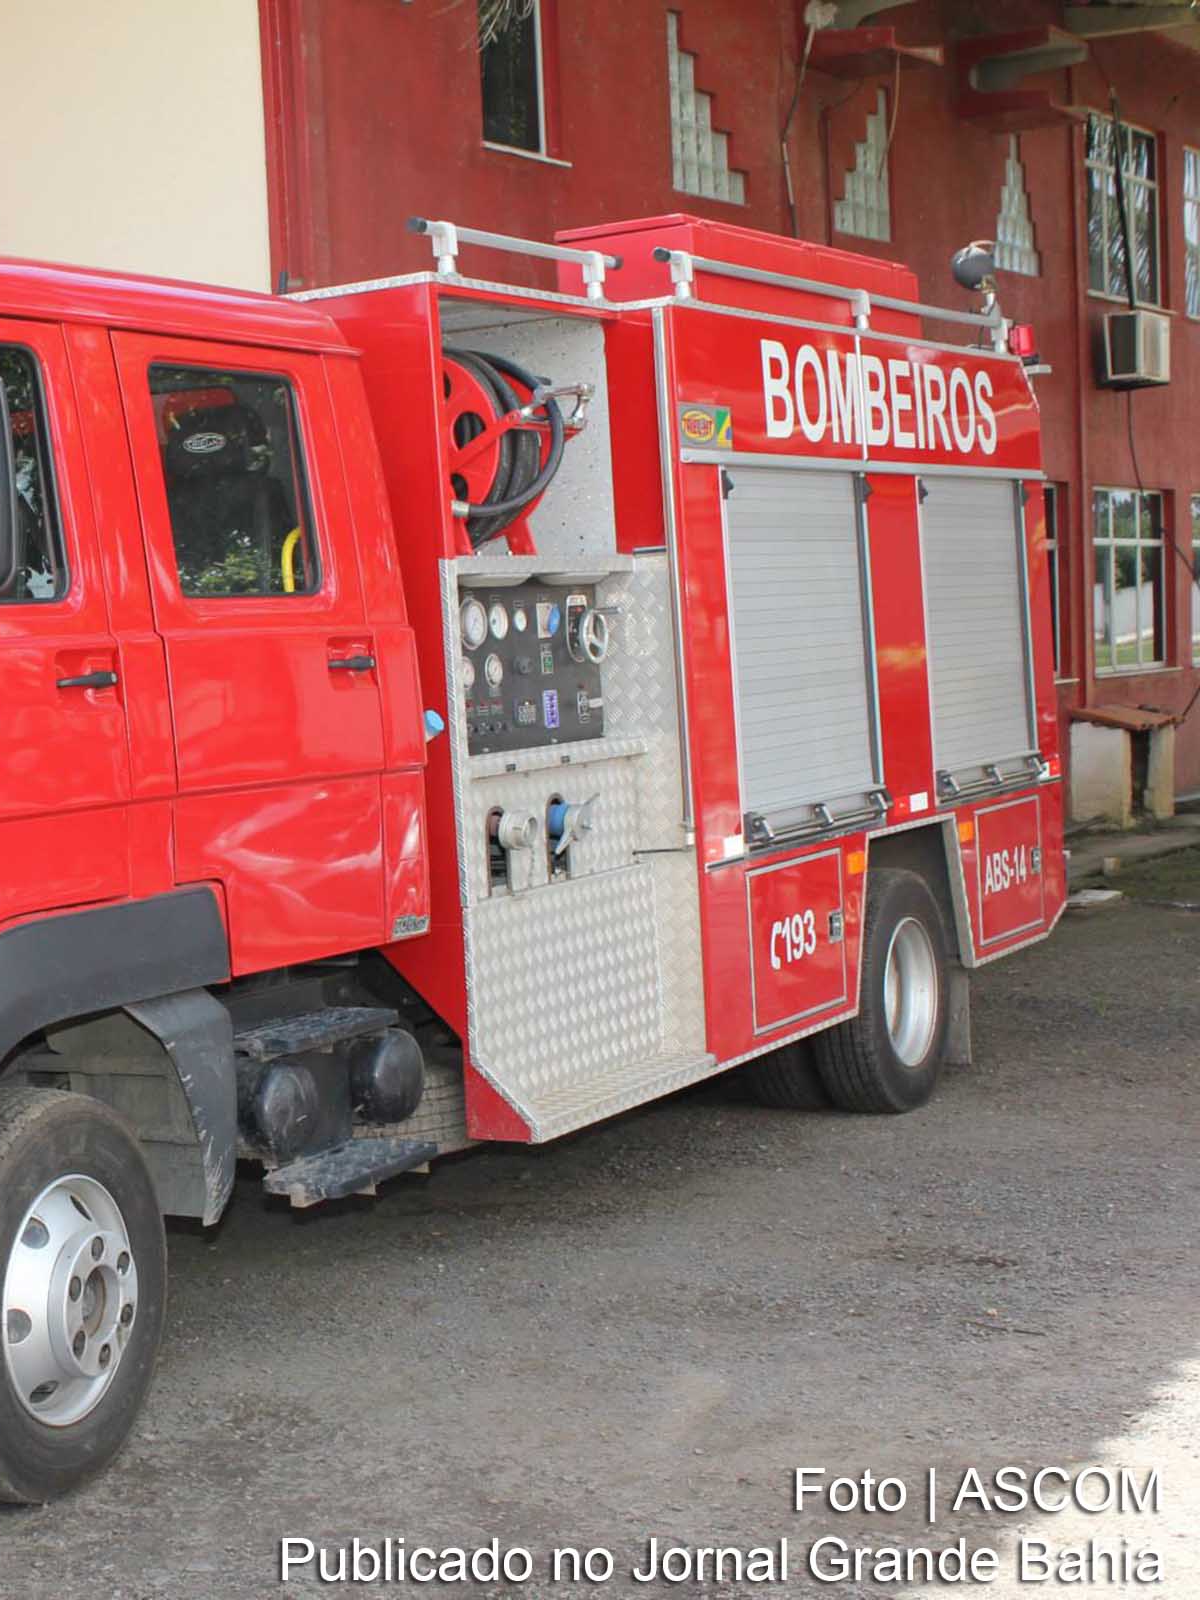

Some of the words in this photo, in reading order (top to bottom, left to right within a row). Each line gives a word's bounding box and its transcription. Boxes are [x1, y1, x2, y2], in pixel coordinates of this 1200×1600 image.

[760, 338, 998, 455] BOMBEIROS
[984, 844, 1027, 896] ABS-14
[781, 908, 817, 963] 193
